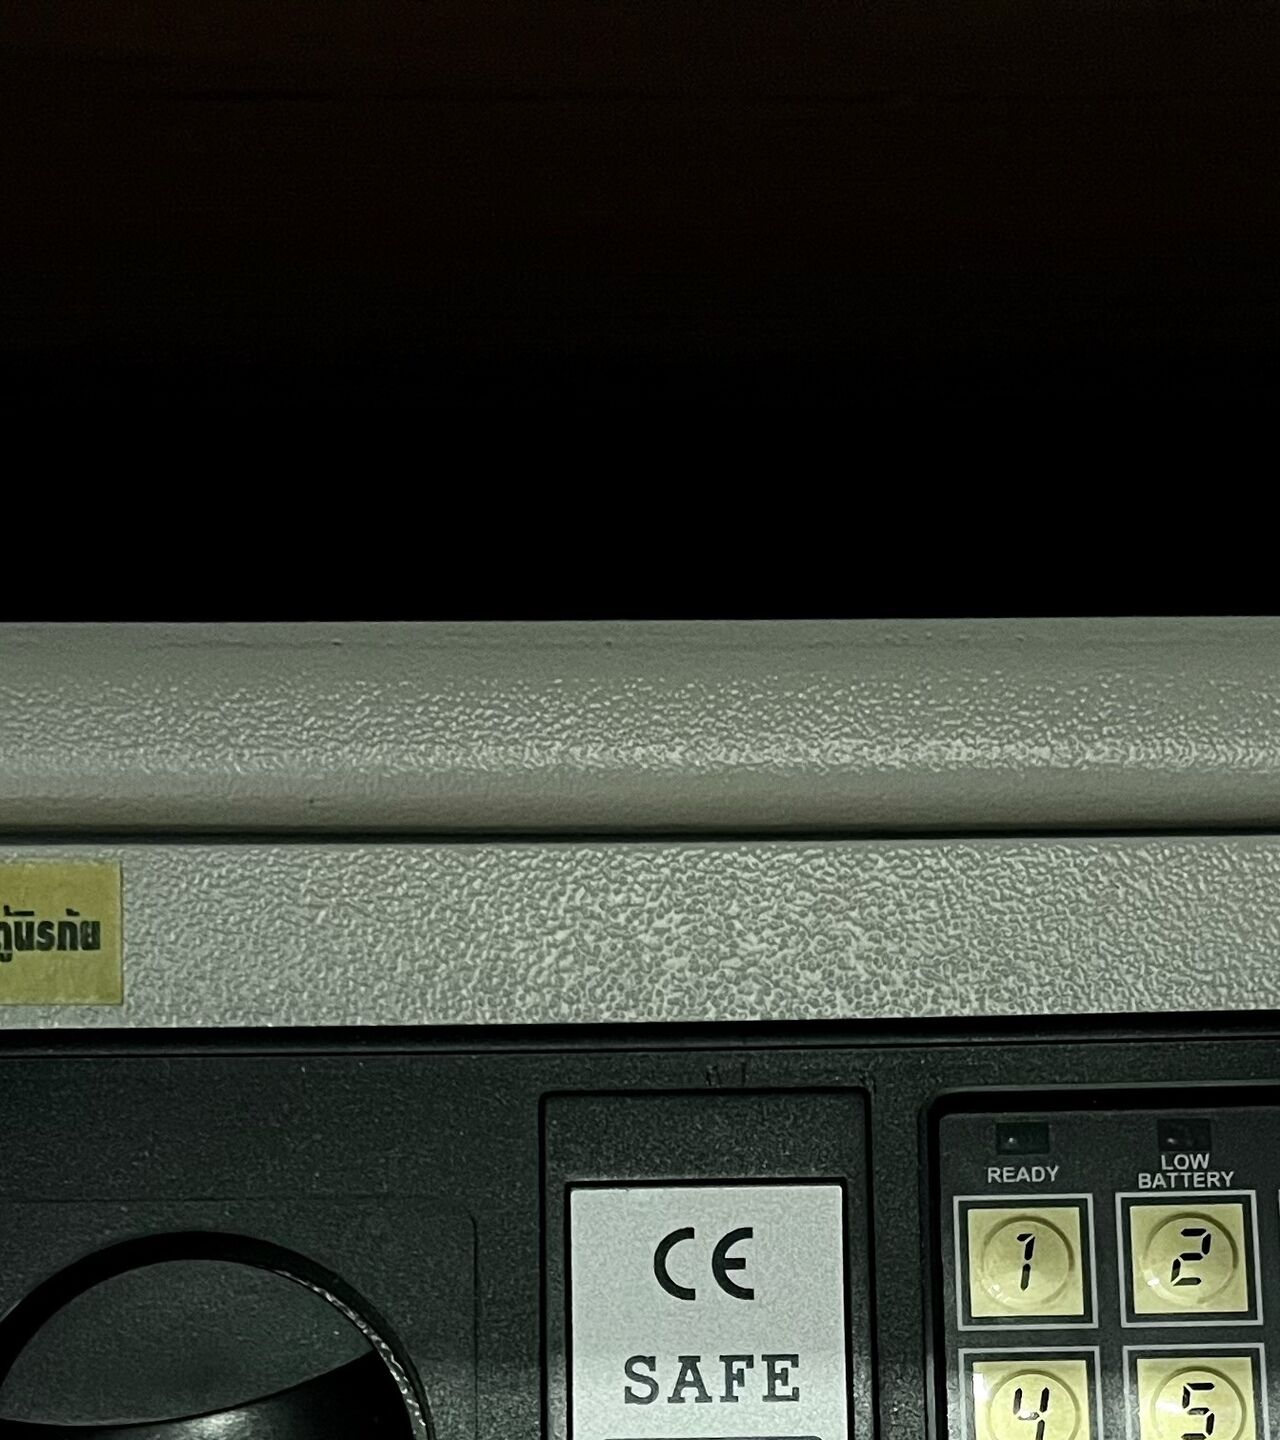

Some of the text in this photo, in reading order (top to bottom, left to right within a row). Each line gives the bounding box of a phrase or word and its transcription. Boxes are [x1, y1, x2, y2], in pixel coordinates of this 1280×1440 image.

[986, 1166, 1060, 1184] READY
[1137, 1170, 1235, 1189] BATTERY
[1160, 1153, 1210, 1170] LOW
[652, 1226, 755, 1301] CE
[1016, 1232, 1036, 1291] 1
[1170, 1227, 1211, 1287] 2
[623, 1353, 801, 1405] SAFE
[1180, 1382, 1216, 1440] 5
